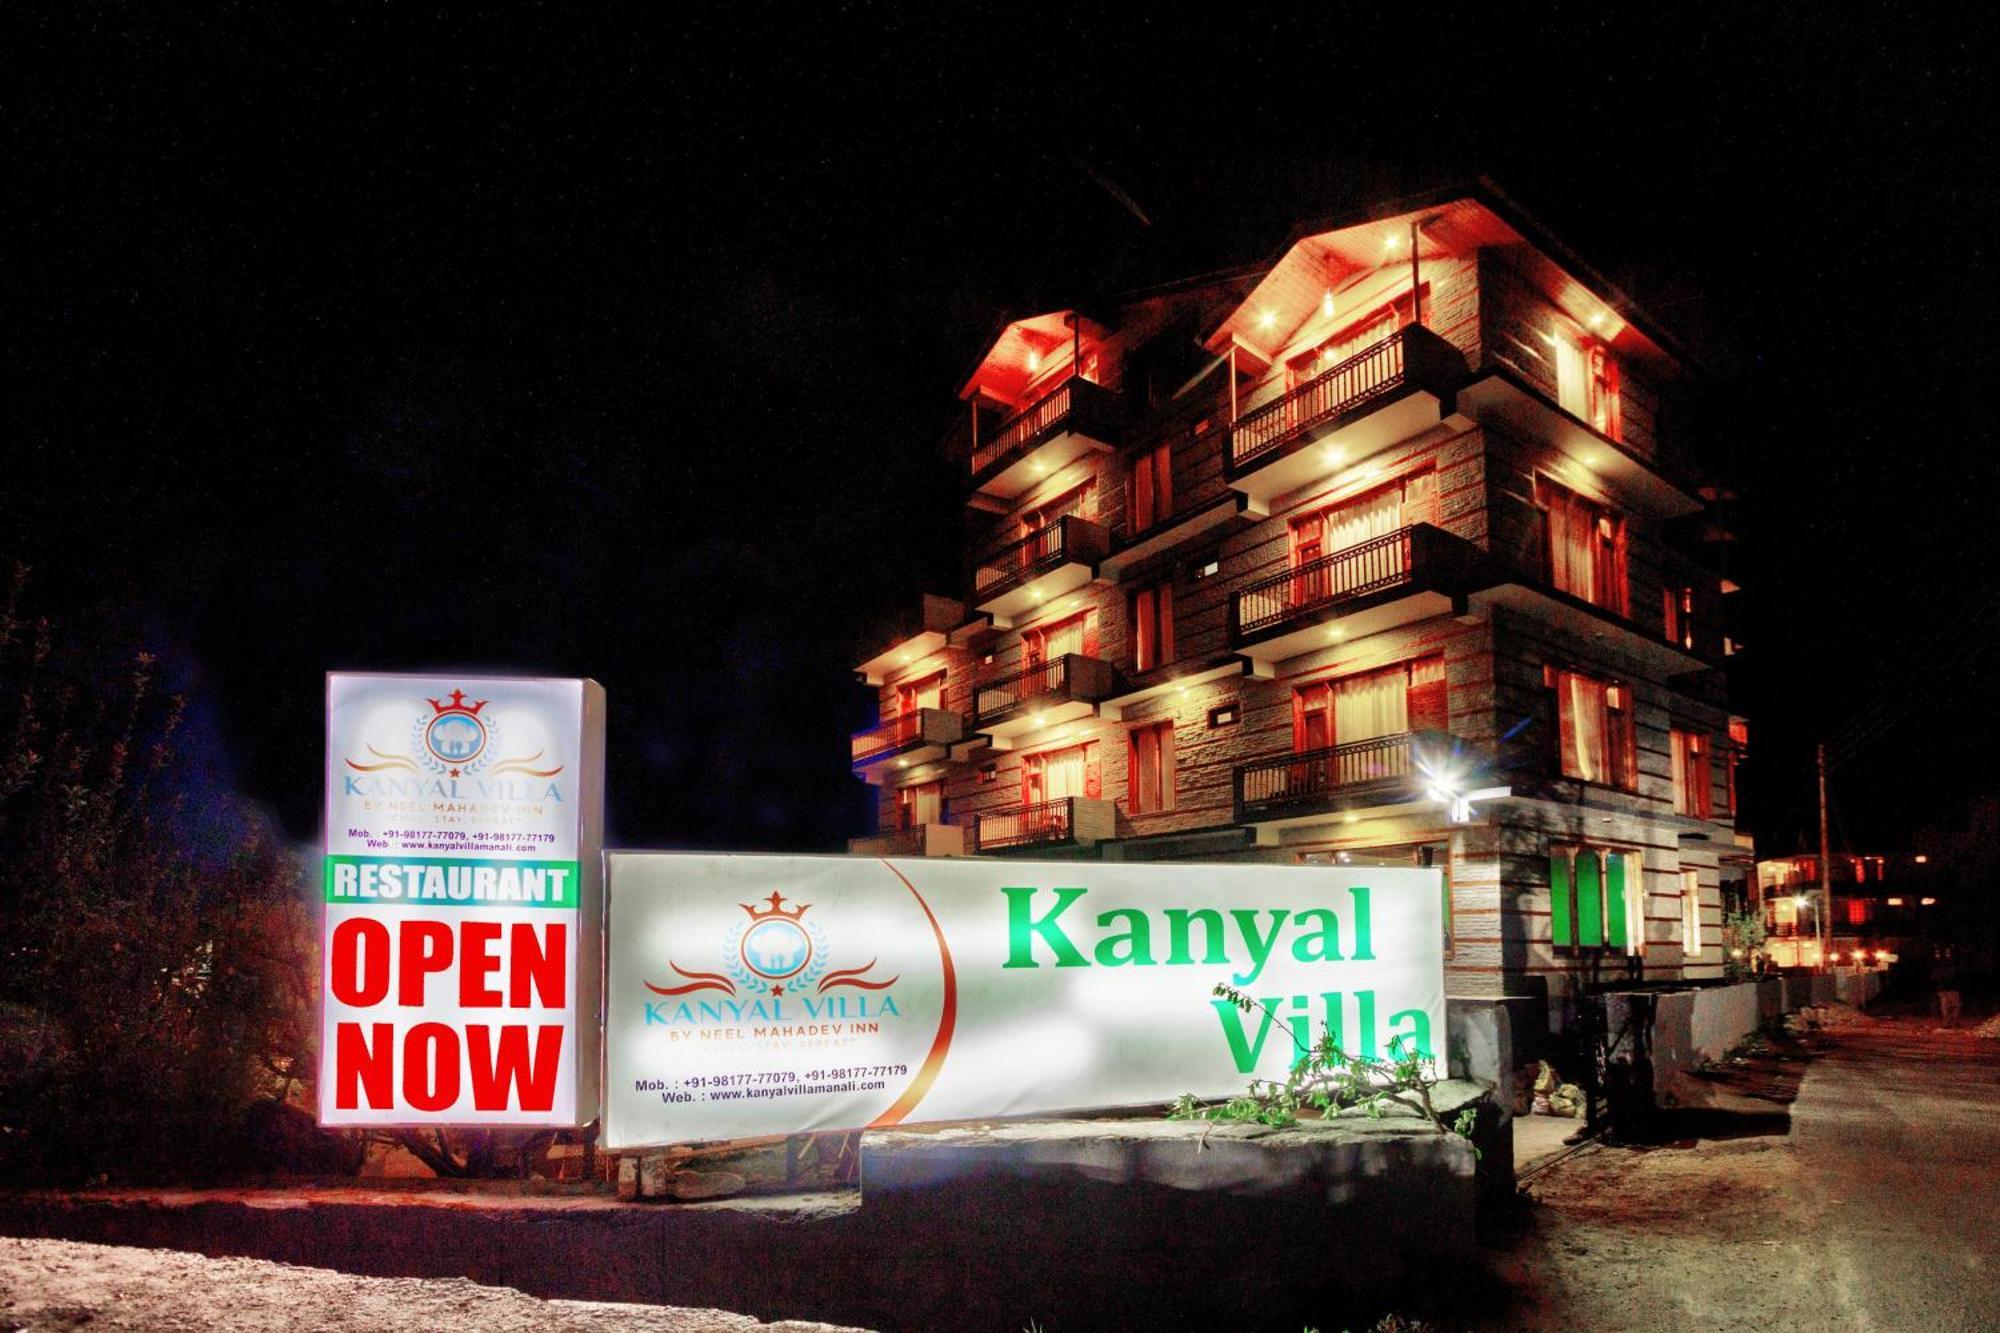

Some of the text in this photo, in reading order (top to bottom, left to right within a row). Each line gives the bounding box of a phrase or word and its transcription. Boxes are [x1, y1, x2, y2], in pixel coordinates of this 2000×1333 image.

[344, 775, 563, 802] KANYAL VILLA
[334, 863, 569, 901] RESTAURANT
[1000, 887, 1377, 986] Kanyal
[331, 917, 567, 1009] OPEN
[642, 995, 901, 1026] KANYAL VILLA
[670, 1022, 880, 1042] BY NEEL MAHADEV INN
[1210, 990, 1437, 1074] Villa
[335, 1022, 565, 1113] NOW
[683, 1072, 801, 1089] +91-98177-77079,
[804, 1065, 908, 1082] +91-98177-77179
[710, 1080, 886, 1102] www.kanyalvillamanali.com
